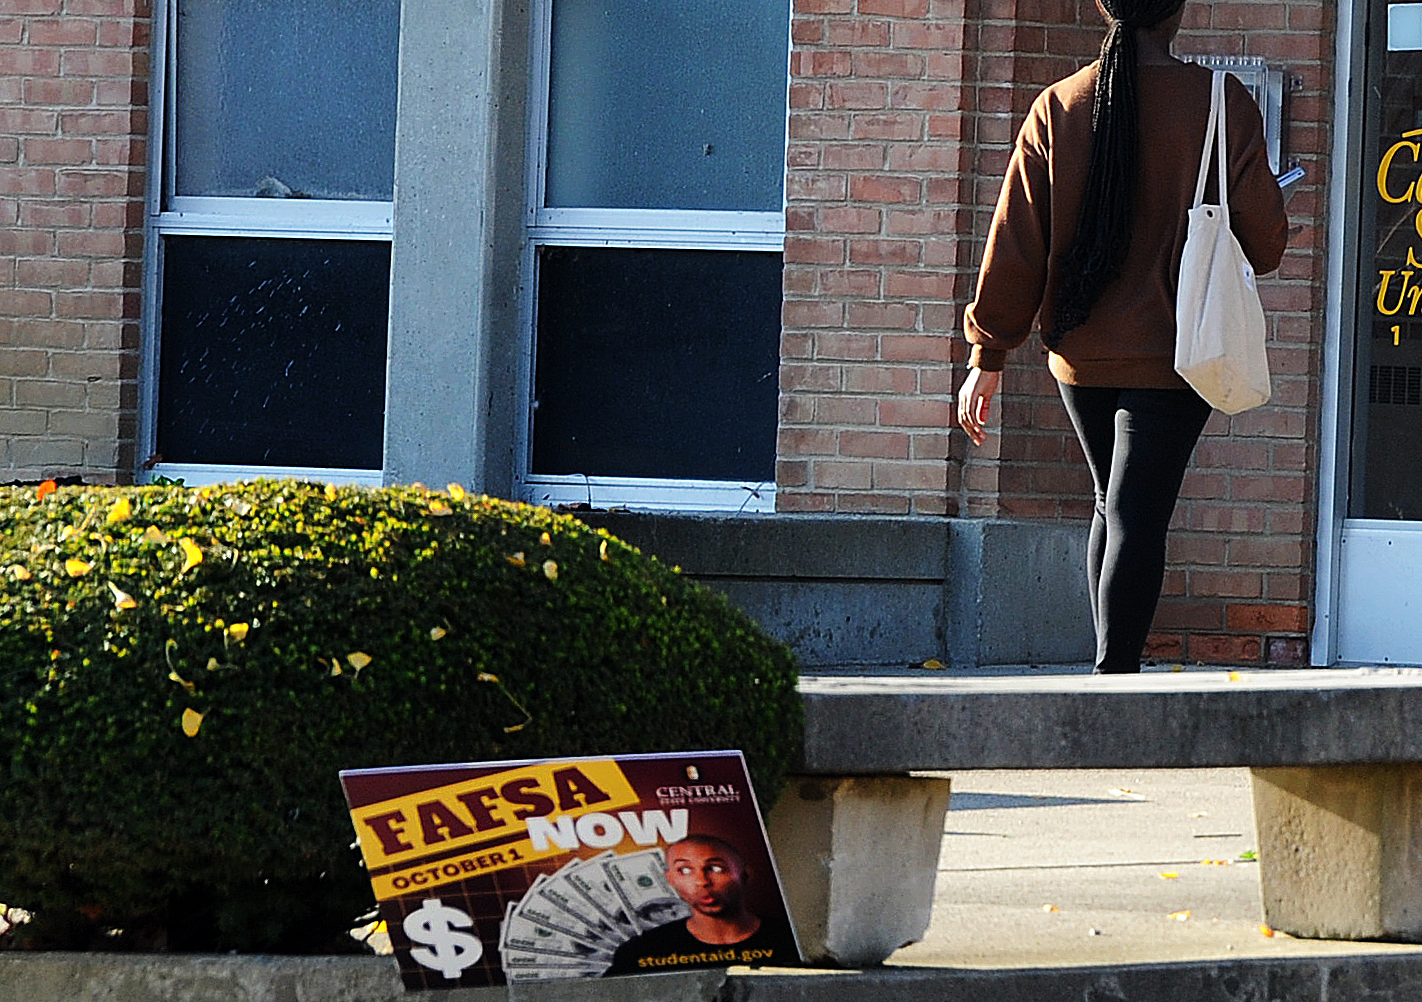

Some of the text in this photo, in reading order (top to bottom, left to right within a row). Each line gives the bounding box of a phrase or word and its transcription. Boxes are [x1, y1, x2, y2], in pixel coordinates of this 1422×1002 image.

[362, 765, 612, 857] FAFSA
[656, 783, 740, 799] CENTRAL
[525, 808, 689, 853] NOW
[392, 847, 524, 890] OCTOBER 1
[637, 946, 774, 968] studentaid.gov
